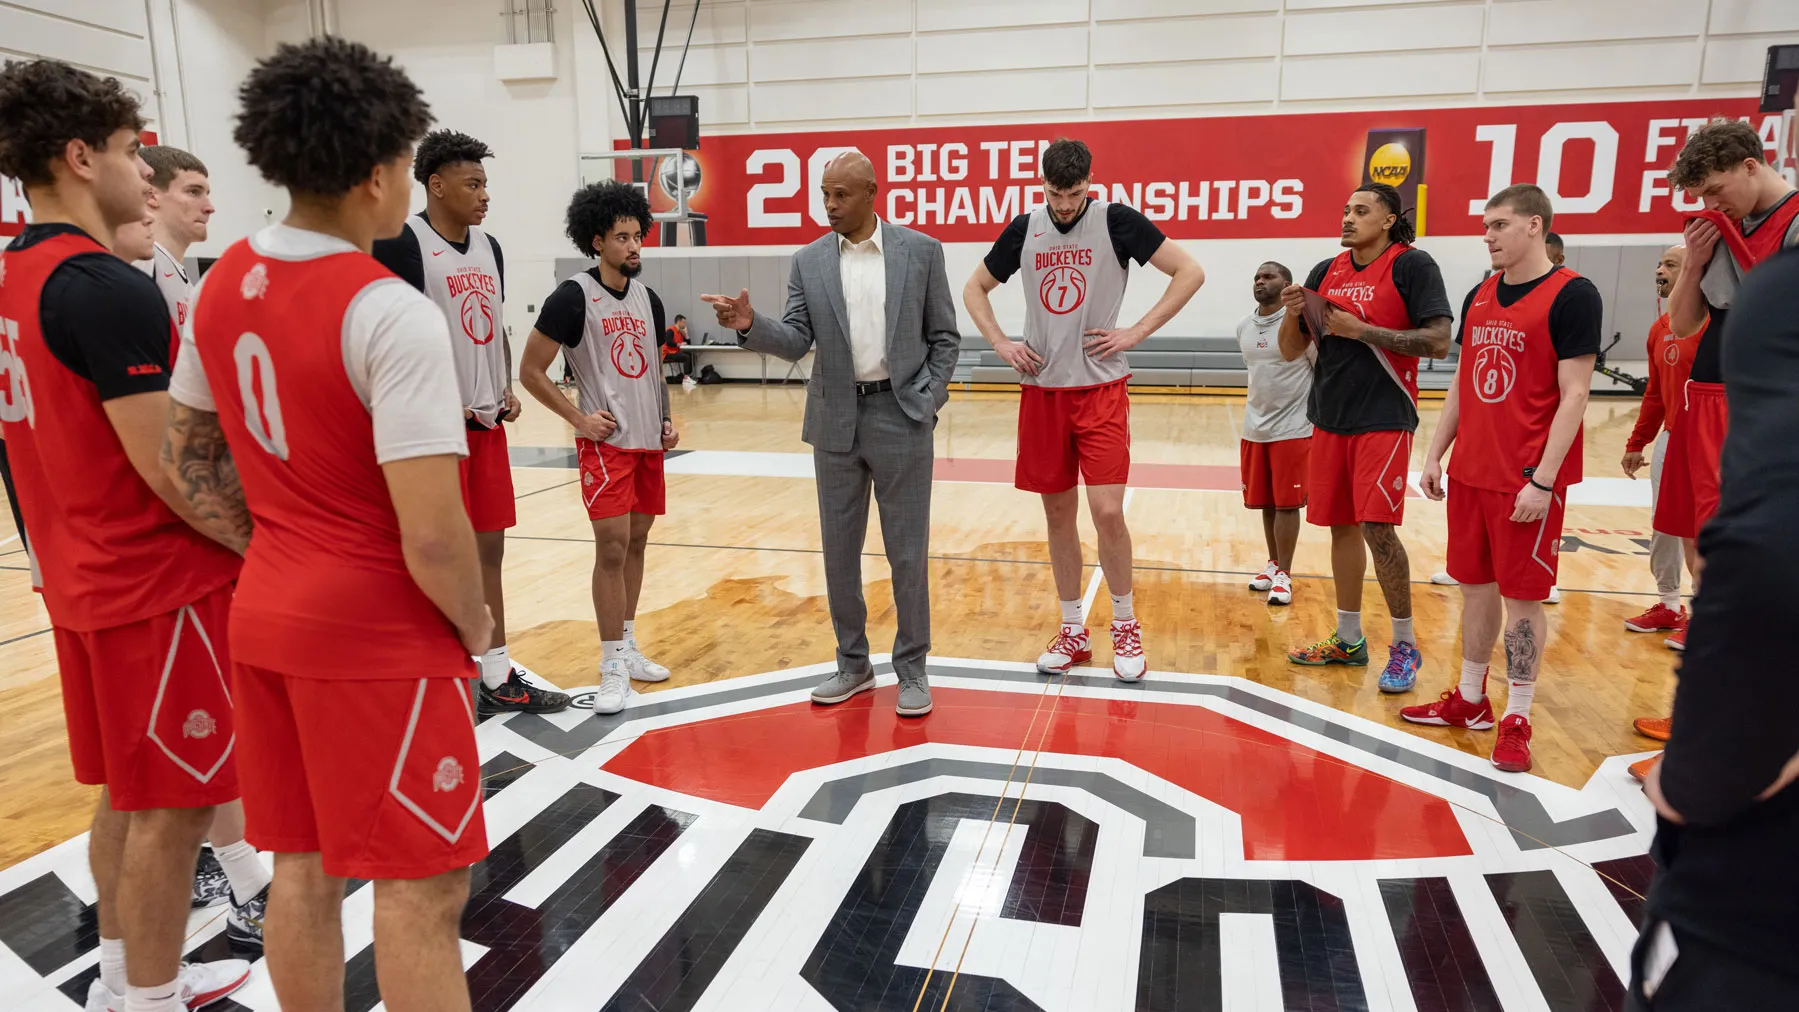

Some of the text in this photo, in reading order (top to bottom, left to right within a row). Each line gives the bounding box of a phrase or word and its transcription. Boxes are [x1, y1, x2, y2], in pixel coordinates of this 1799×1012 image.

[887, 142, 968, 183] BIG
[1372, 164, 1409, 178] NCAA
[1467, 120, 1620, 216] 10
[1035, 248, 1093, 271] BUCKEYES
[446, 272, 496, 299] BUCKEYES
[1057, 285, 1068, 308] 7
[601, 316, 647, 337] BUCKEYES
[1471, 325, 1526, 353] BUCKEYES
[1483, 368, 1498, 395] 8
[233, 331, 290, 461] 0
